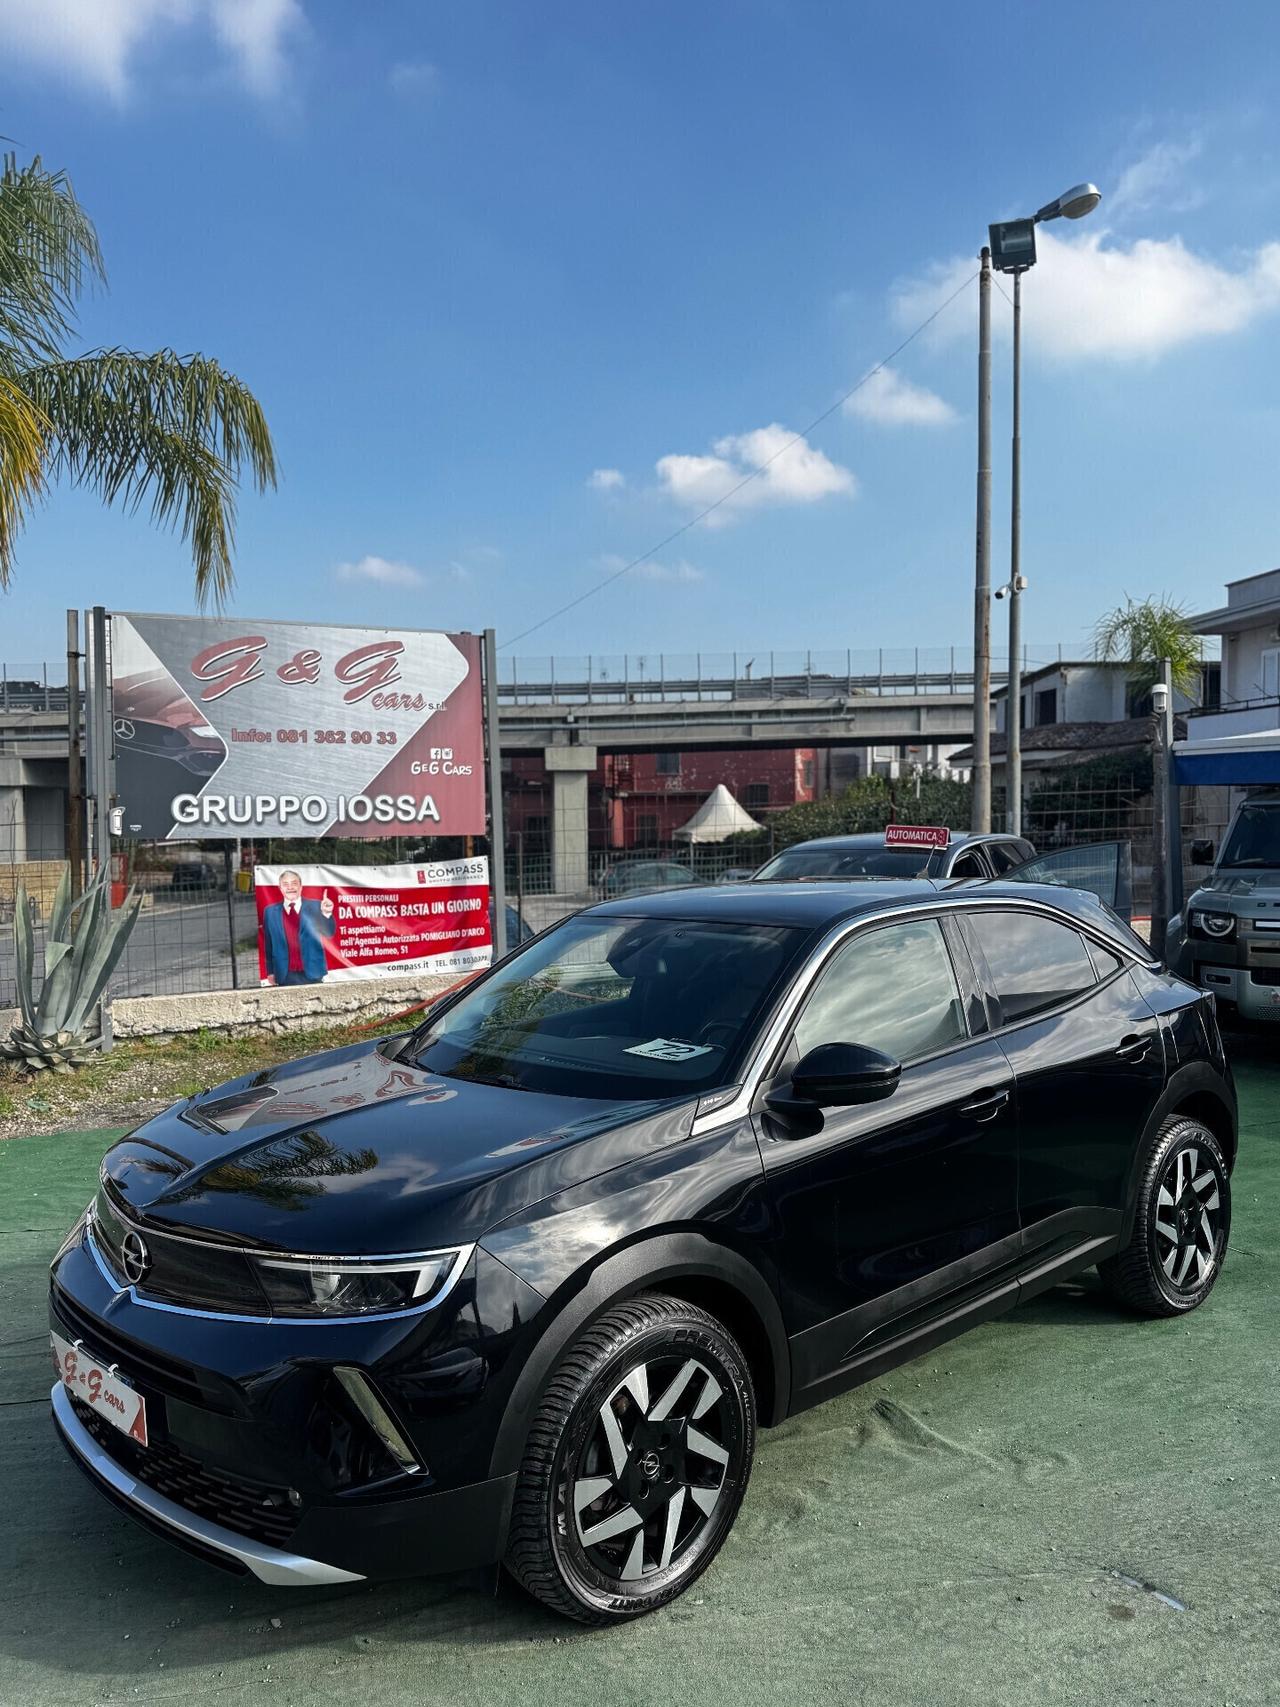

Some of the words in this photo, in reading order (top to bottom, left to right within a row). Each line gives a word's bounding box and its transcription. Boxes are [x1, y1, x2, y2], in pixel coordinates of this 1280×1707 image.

[276, 650, 322, 684] &
[372, 692, 427, 711] cars
[231, 728, 272, 742] Info:
[277, 729, 307, 743] 081
[351, 731, 372, 744] 90
[376, 731, 397, 744] 33
[171, 795, 328, 823] GRUPPO
[338, 795, 441, 822] IOSSA
[887, 829, 937, 841] AUTOMATICA
[428, 864, 484, 878] COMPASS
[365, 894, 399, 903] PERSONALI
[339, 906, 353, 919] DA
[355, 905, 398, 918] COMPASS
[400, 903, 430, 917] BASTA
[431, 901, 445, 914] UN
[446, 898, 482, 913] GIORNO
[340, 926, 347, 935] Ti
[348, 925, 386, 936] aspettiamo
[383, 935, 420, 945] Autorizzata
[420, 930, 461, 941] POMIGLIANO
[461, 927, 485, 937] D'ARCO
[340, 949, 358, 958] Viale
[359, 947, 373, 957] Alfa
[387, 961, 429, 973] compass.it
